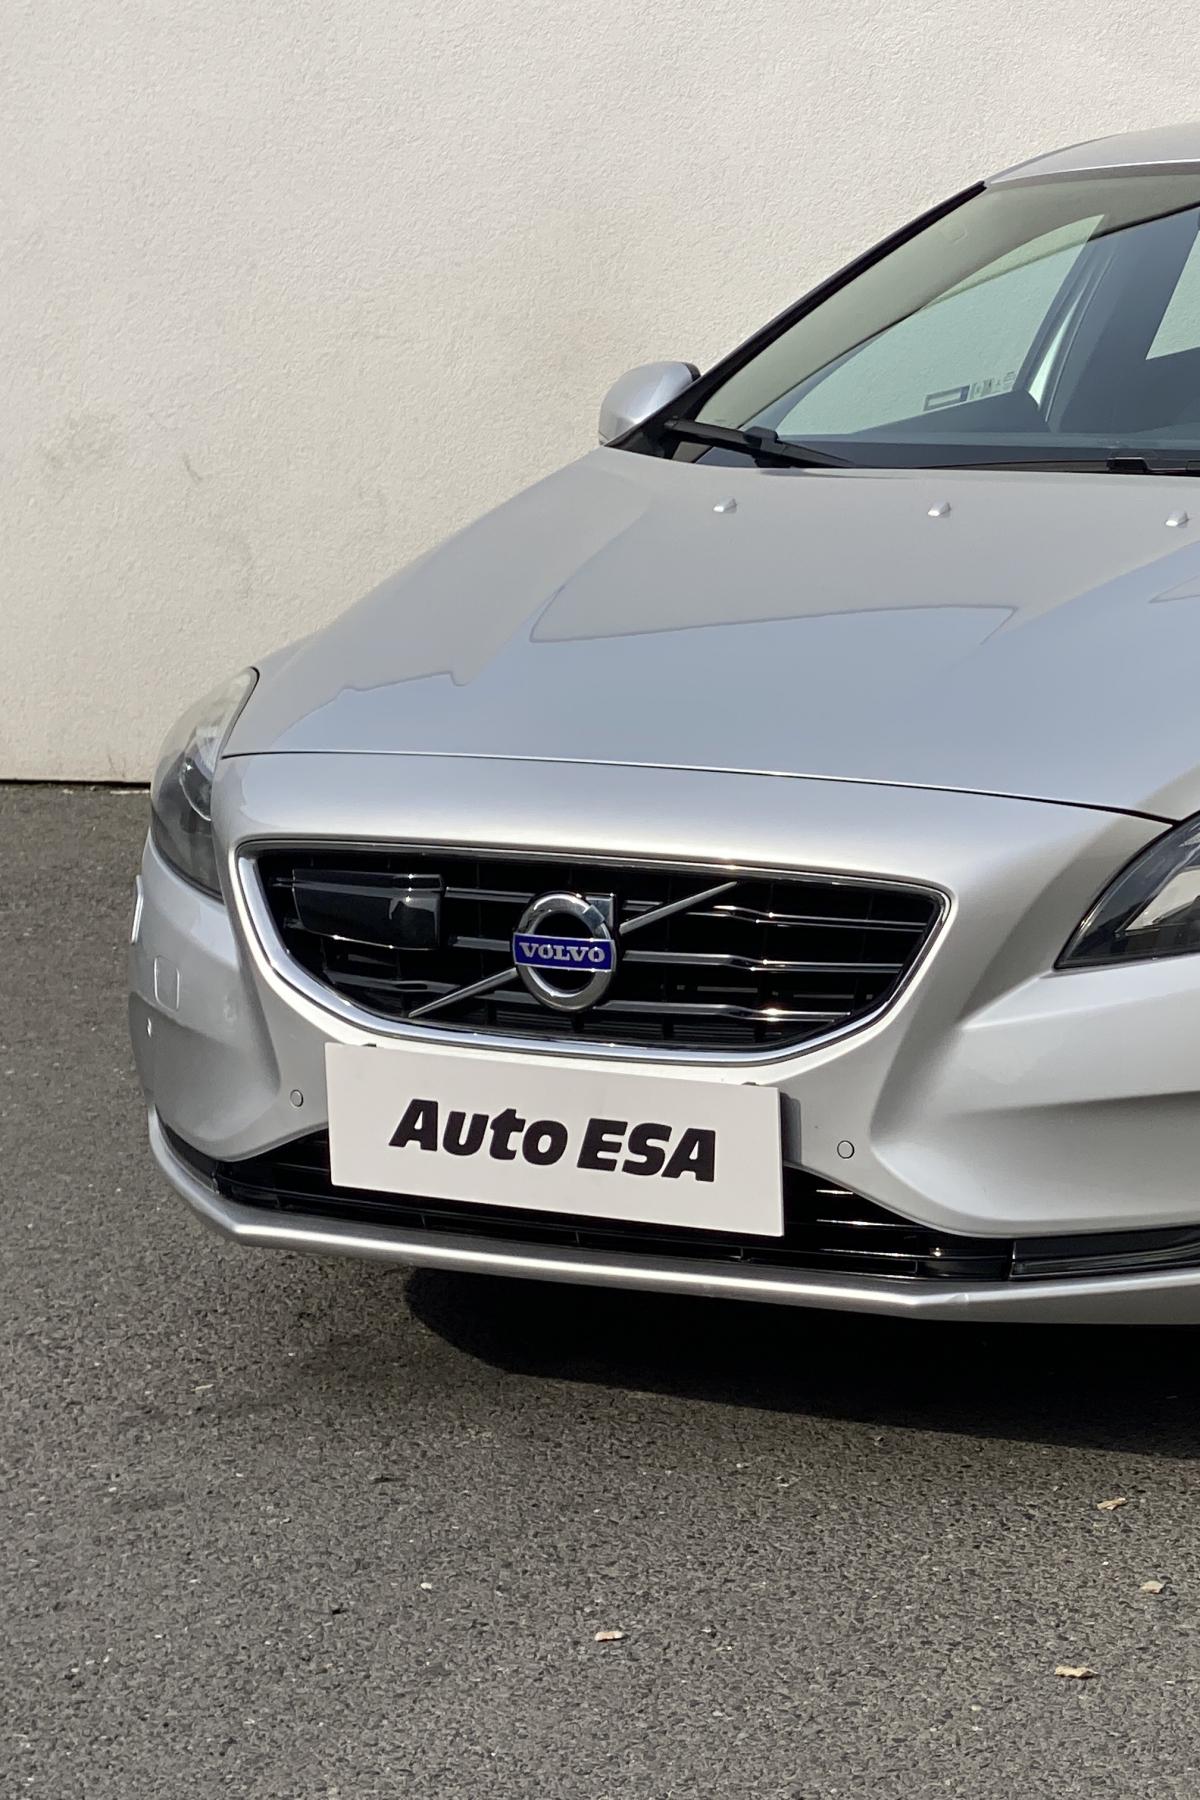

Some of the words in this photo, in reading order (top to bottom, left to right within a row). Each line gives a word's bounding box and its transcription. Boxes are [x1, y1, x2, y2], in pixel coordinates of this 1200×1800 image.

[518, 942, 606, 963] VOLVO
[388, 1098, 569, 1166] Auto
[576, 1117, 716, 1183] ESA
